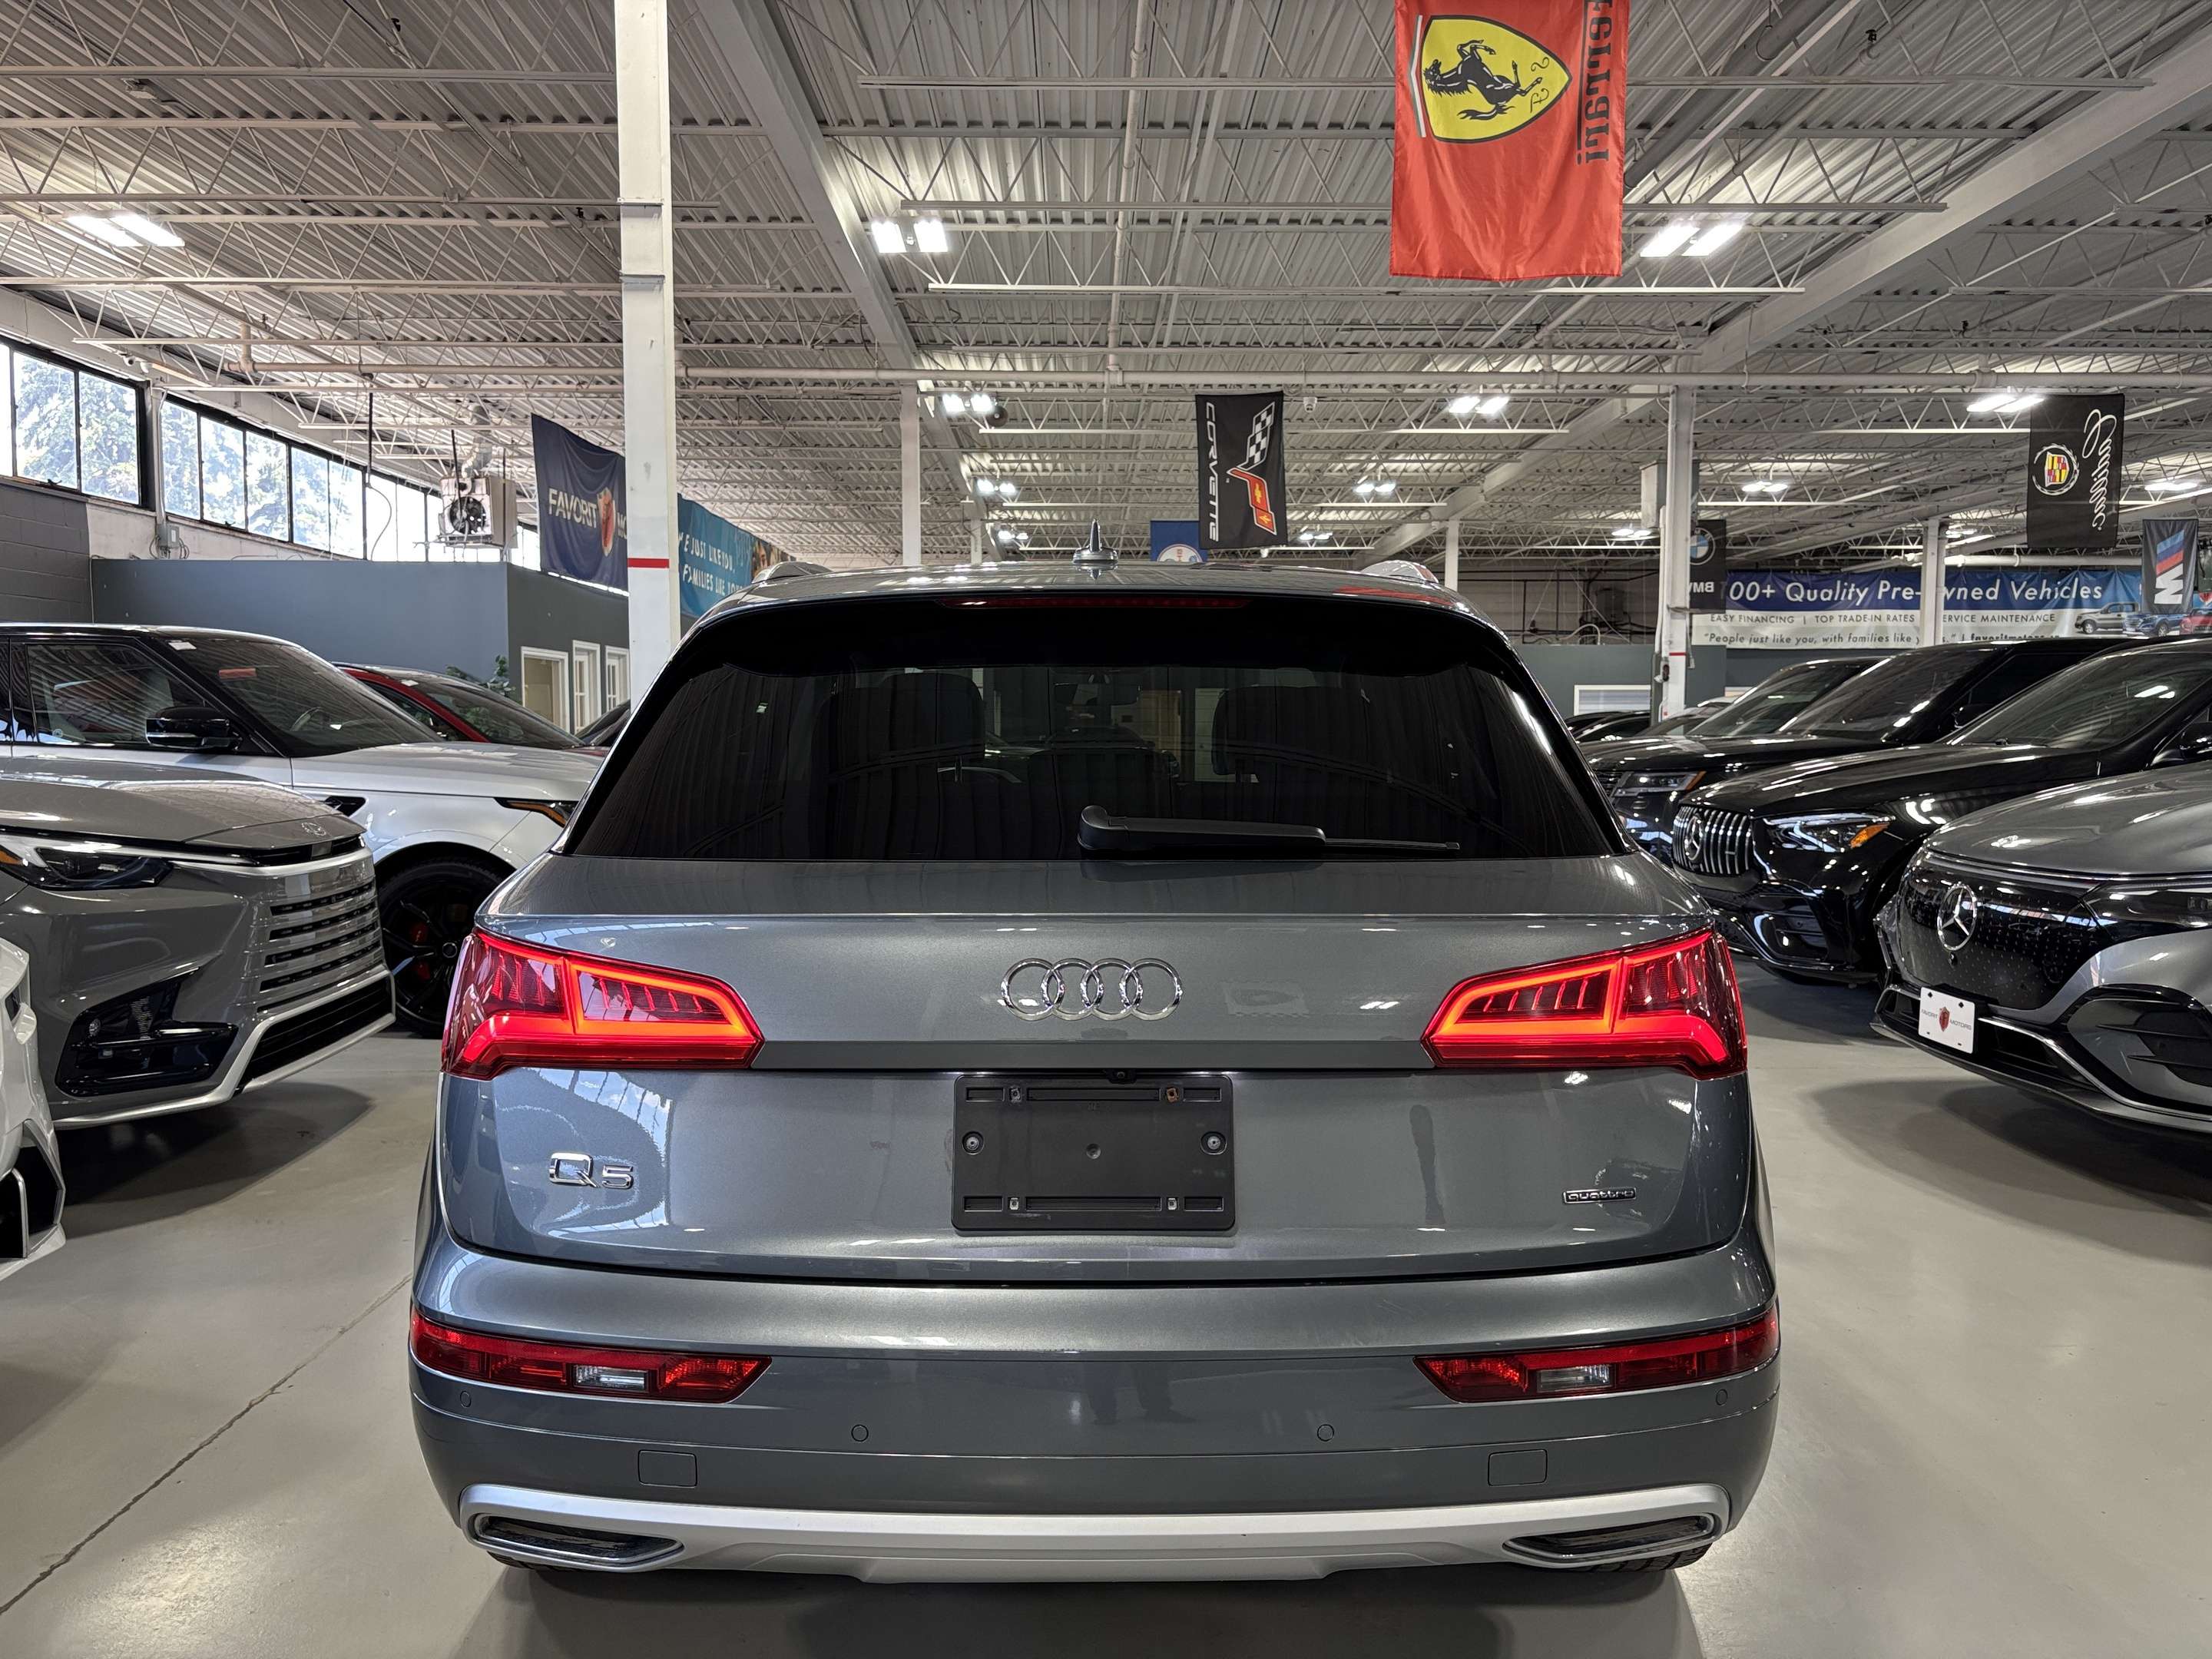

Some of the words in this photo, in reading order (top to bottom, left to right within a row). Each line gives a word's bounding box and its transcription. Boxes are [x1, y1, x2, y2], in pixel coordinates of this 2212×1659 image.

[1206, 402, 1220, 542] CORVETTE
[548, 488, 598, 529] FAVORIT
[1785, 580, 1869, 606] Quality
[2011, 578, 2102, 601] Vehicles
[1738, 616, 1796, 624] FINANCING
[1815, 615, 1834, 624] TOP
[1838, 614, 1882, 623] TRADE-IN
[1886, 614, 1916, 623] RATES
[1942, 614, 1976, 623] ERVICE
[1980, 614, 2056, 623] MAINTENANCE
[1748, 634, 1769, 646] just
[1772, 632, 1792, 644] like
[1794, 636, 1817, 647] you,
[1821, 632, 1843, 643] with
[1847, 632, 1890, 644] families
[1893, 632, 1912, 643] like
